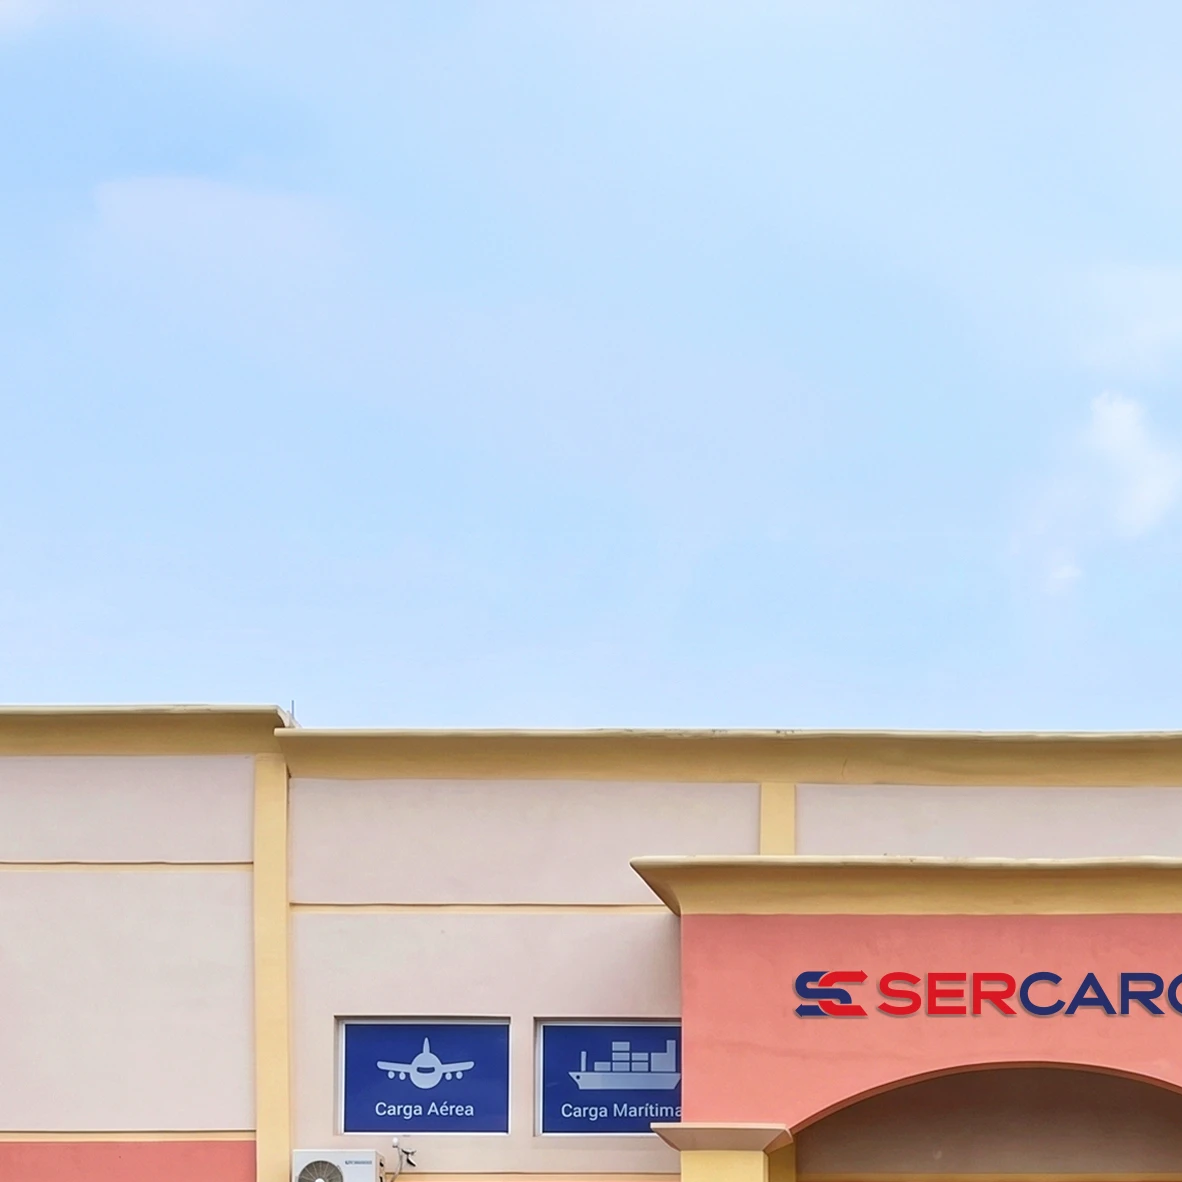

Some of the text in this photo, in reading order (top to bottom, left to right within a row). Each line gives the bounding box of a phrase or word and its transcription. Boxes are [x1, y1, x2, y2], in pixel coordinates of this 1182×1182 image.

[375, 1101, 474, 1119] Carga Aérea
[561, 1103, 682, 1121] Carga Marítima
